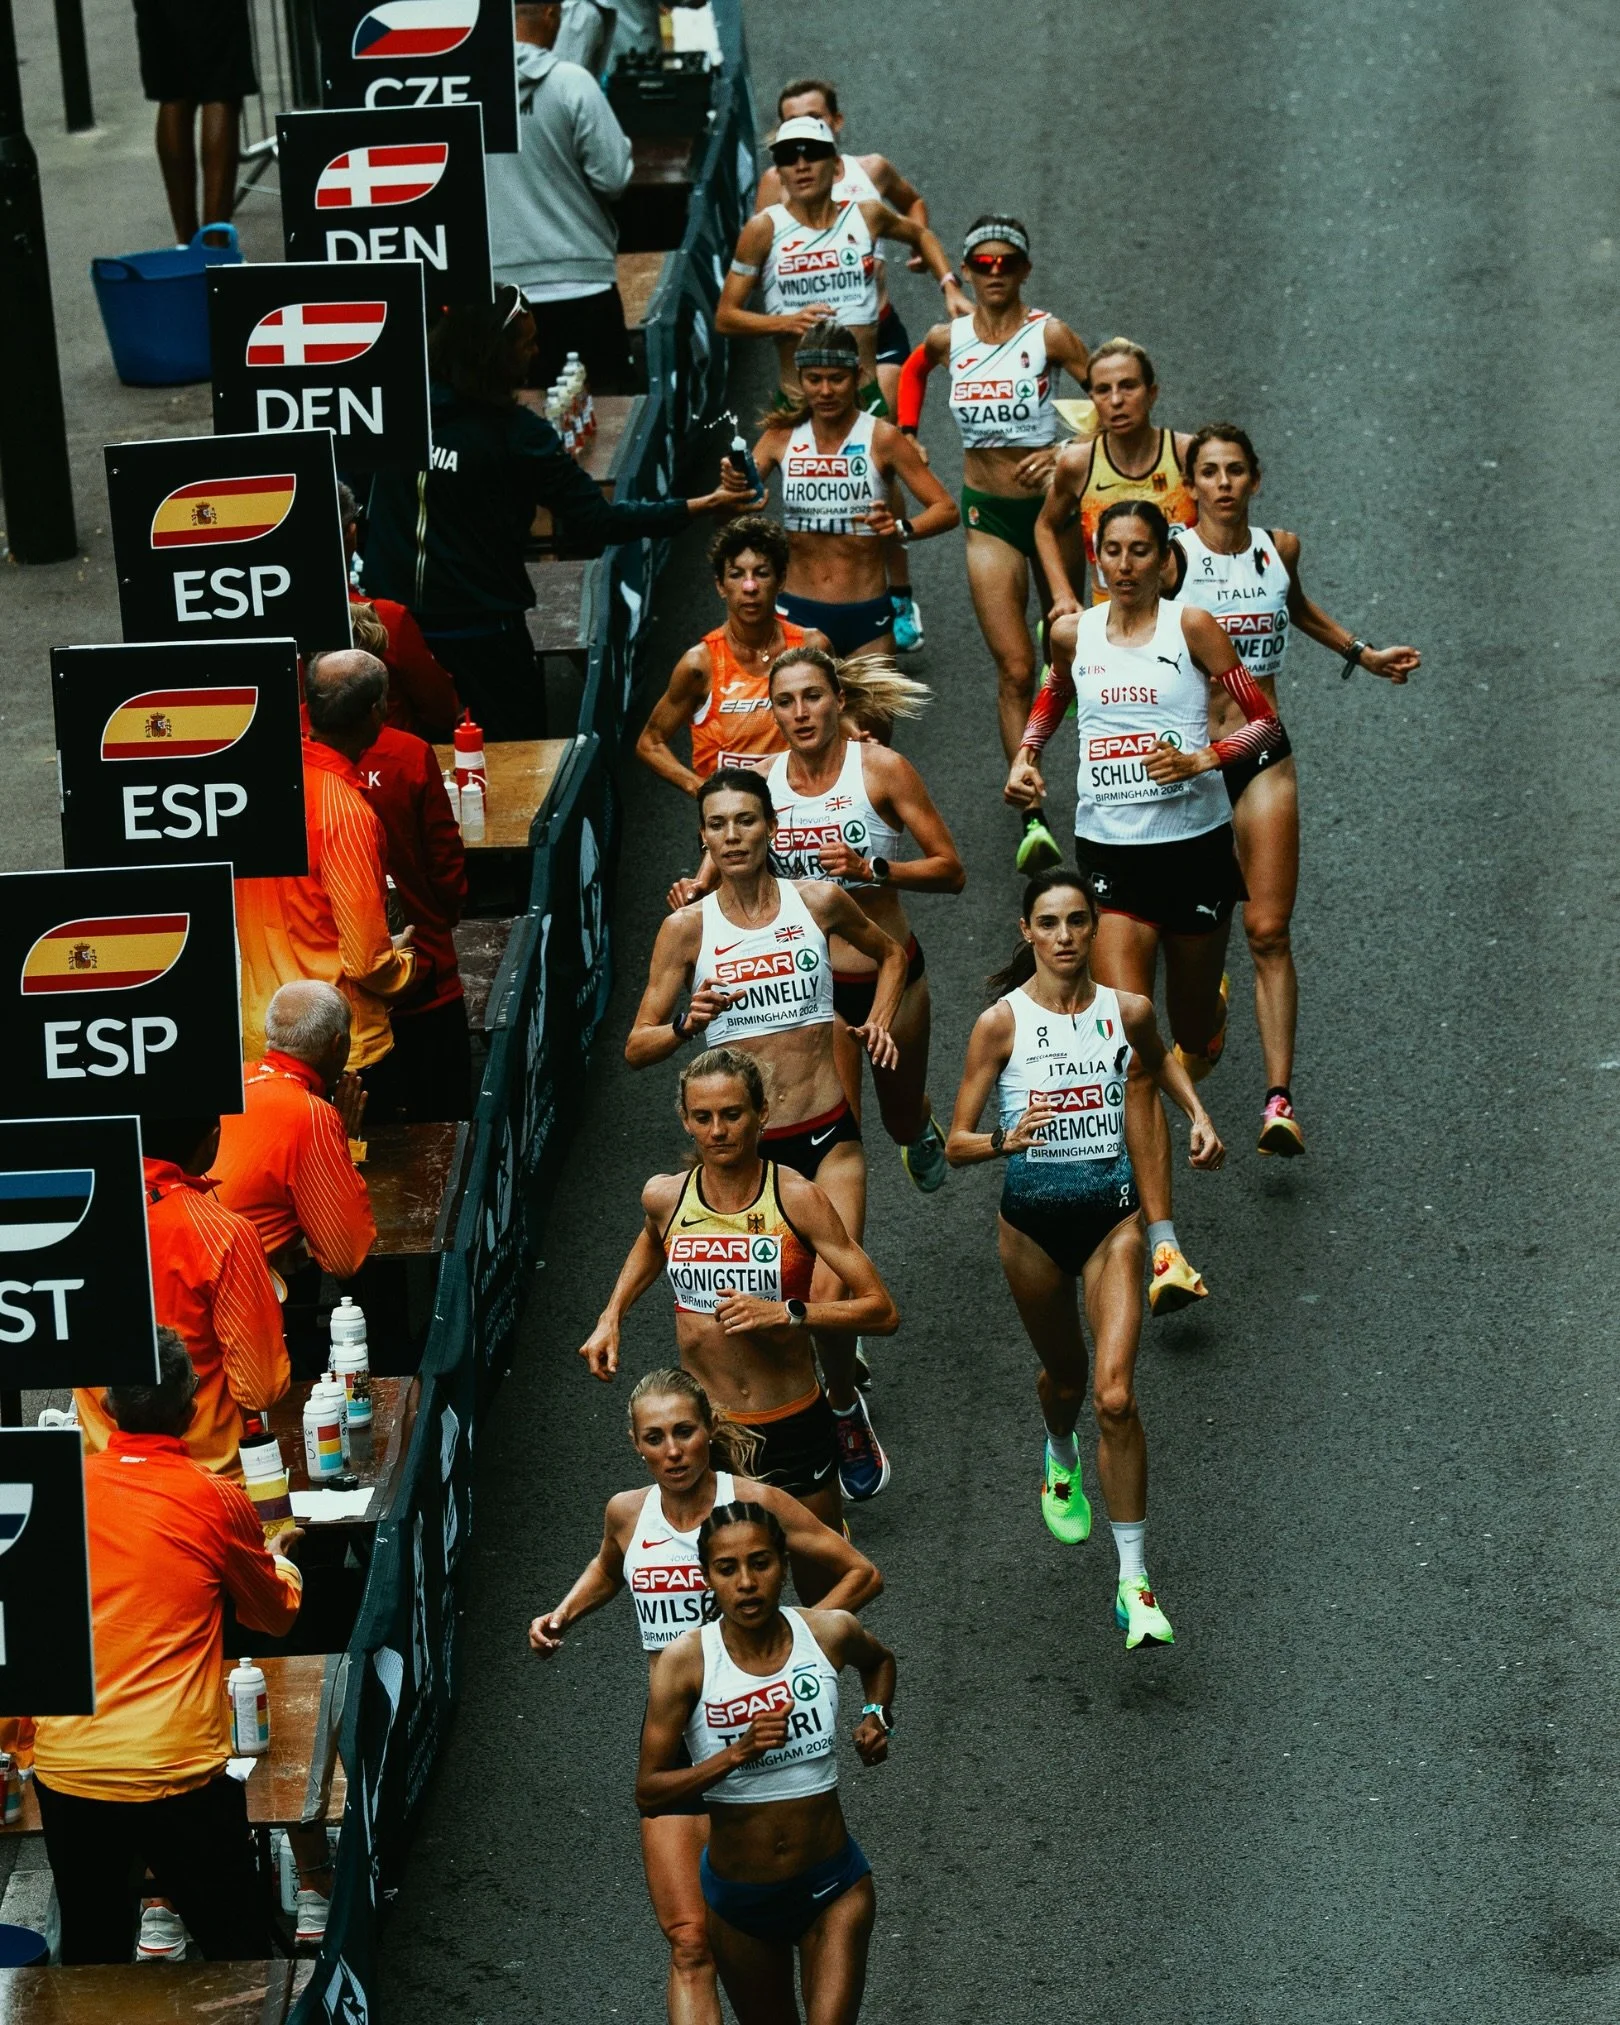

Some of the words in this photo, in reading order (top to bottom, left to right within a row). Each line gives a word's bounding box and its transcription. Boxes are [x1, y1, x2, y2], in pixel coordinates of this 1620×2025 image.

[365, 76, 471, 109] CZE
[325, 224, 448, 270] DEN
[780, 252, 838, 273] SPAR
[956, 382, 1013, 400] SPAR
[256, 386, 384, 435] DEN
[789, 459, 847, 476] SPAR
[173, 564, 291, 622] ESP
[1217, 586, 1267, 601] ITALIA
[1233, 635, 1285, 658] NEDO
[1087, 665, 1106, 675] UBS
[720, 697, 773, 713] ESP
[1090, 735, 1156, 759] SPAR
[1091, 763, 1151, 788] SCHLU
[1095, 788, 1159, 802] BIRMINGHAM
[1161, 783, 1184, 796] 2026
[122, 783, 248, 840] ESP
[776, 828, 840, 848] SPAR
[718, 955, 793, 981] SPAR
[727, 1008, 798, 1027] BIRMINGHAM
[799, 1004, 819, 1016] 2026
[44, 1016, 178, 1079] ESP
[1049, 1060, 1107, 1077] ITALIA
[1033, 1111, 1124, 1142] AREMCHUK
[1031, 1145, 1105, 1158] BIRMINGHAM
[674, 1240, 748, 1259] SPAR
[670, 1263, 777, 1292] KÖNIGSTEIN
[0, 1279, 85, 1343] ST
[680, 1294, 724, 1309] BIRMING
[634, 1568, 708, 1590] SPAR
[708, 1685, 790, 1725] SPAR
[805, 1735, 834, 1755] 2026
